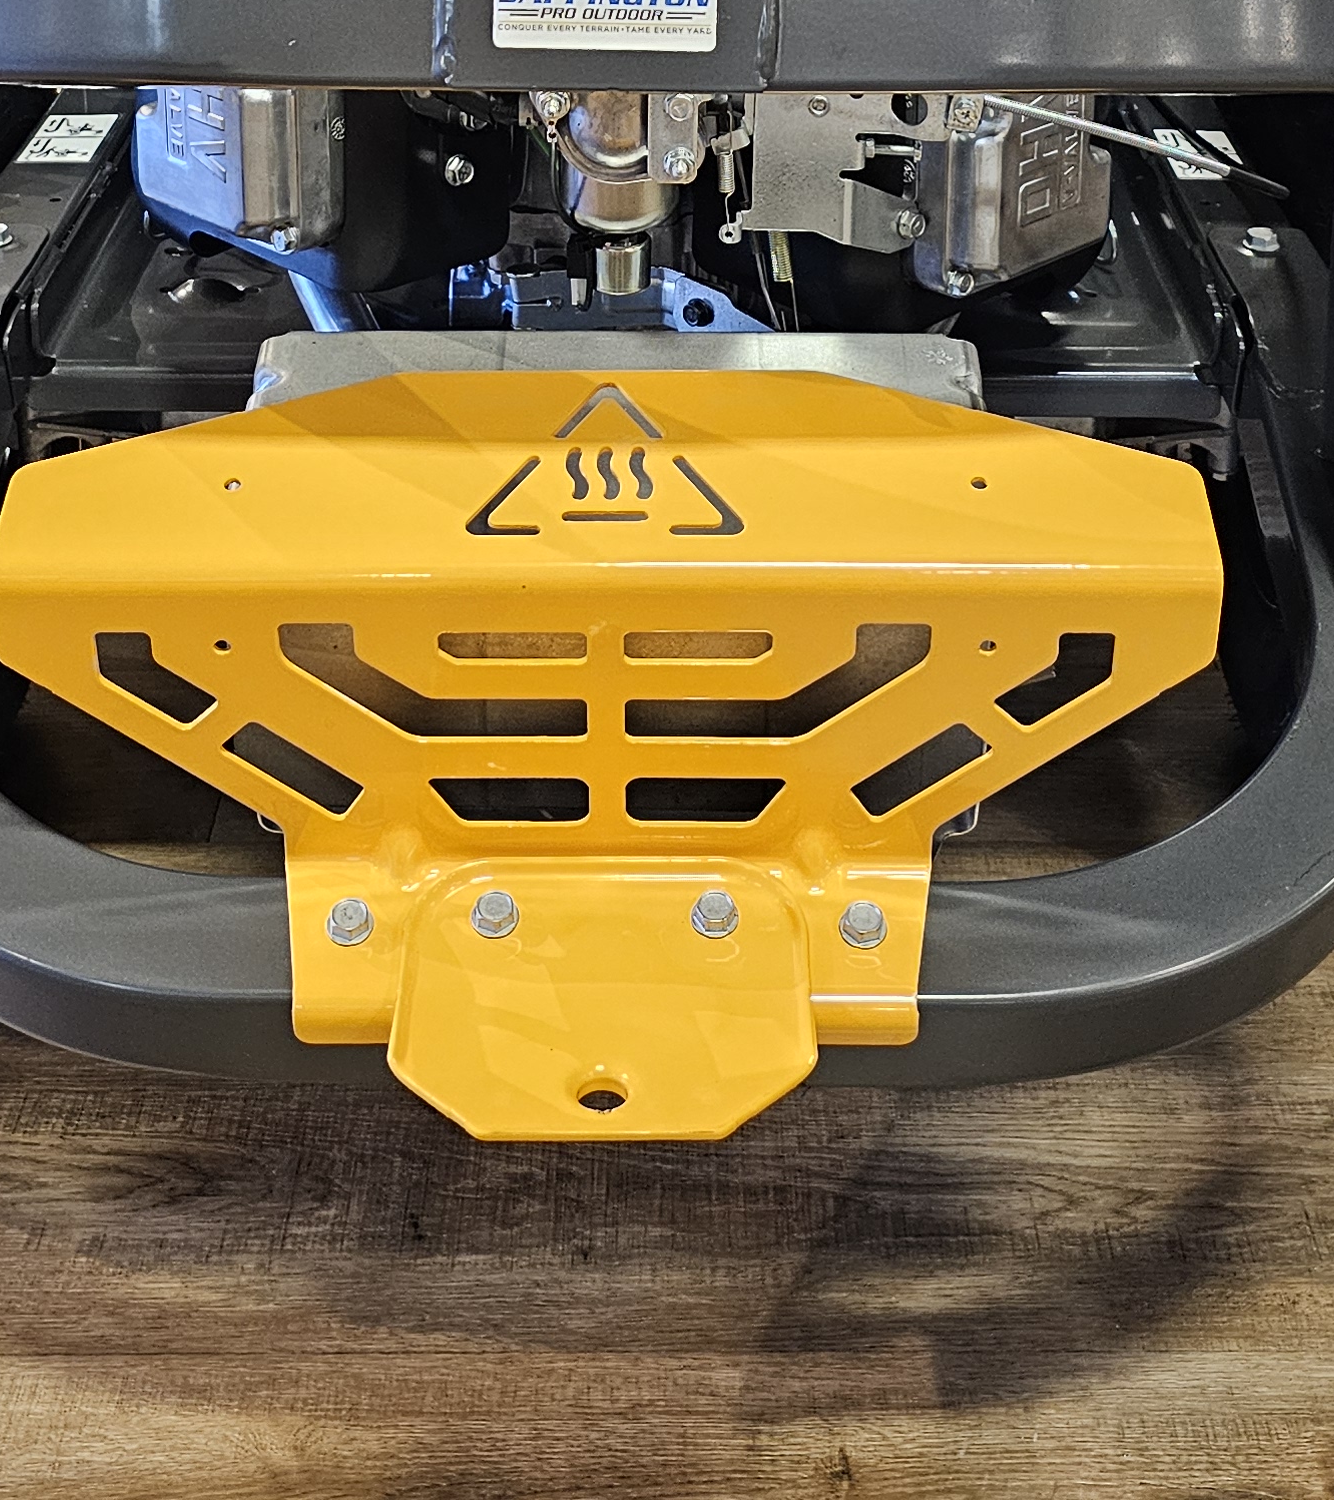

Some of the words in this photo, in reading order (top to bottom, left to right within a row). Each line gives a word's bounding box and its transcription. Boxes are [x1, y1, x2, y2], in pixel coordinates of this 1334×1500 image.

[540, 7, 577, 20] PRO
[582, 8, 664, 21] OUTDOOR
[497, 23, 544, 32] CONQUER
[547, 24, 577, 33] EVERY
[654, 26, 684, 34] EVERY
